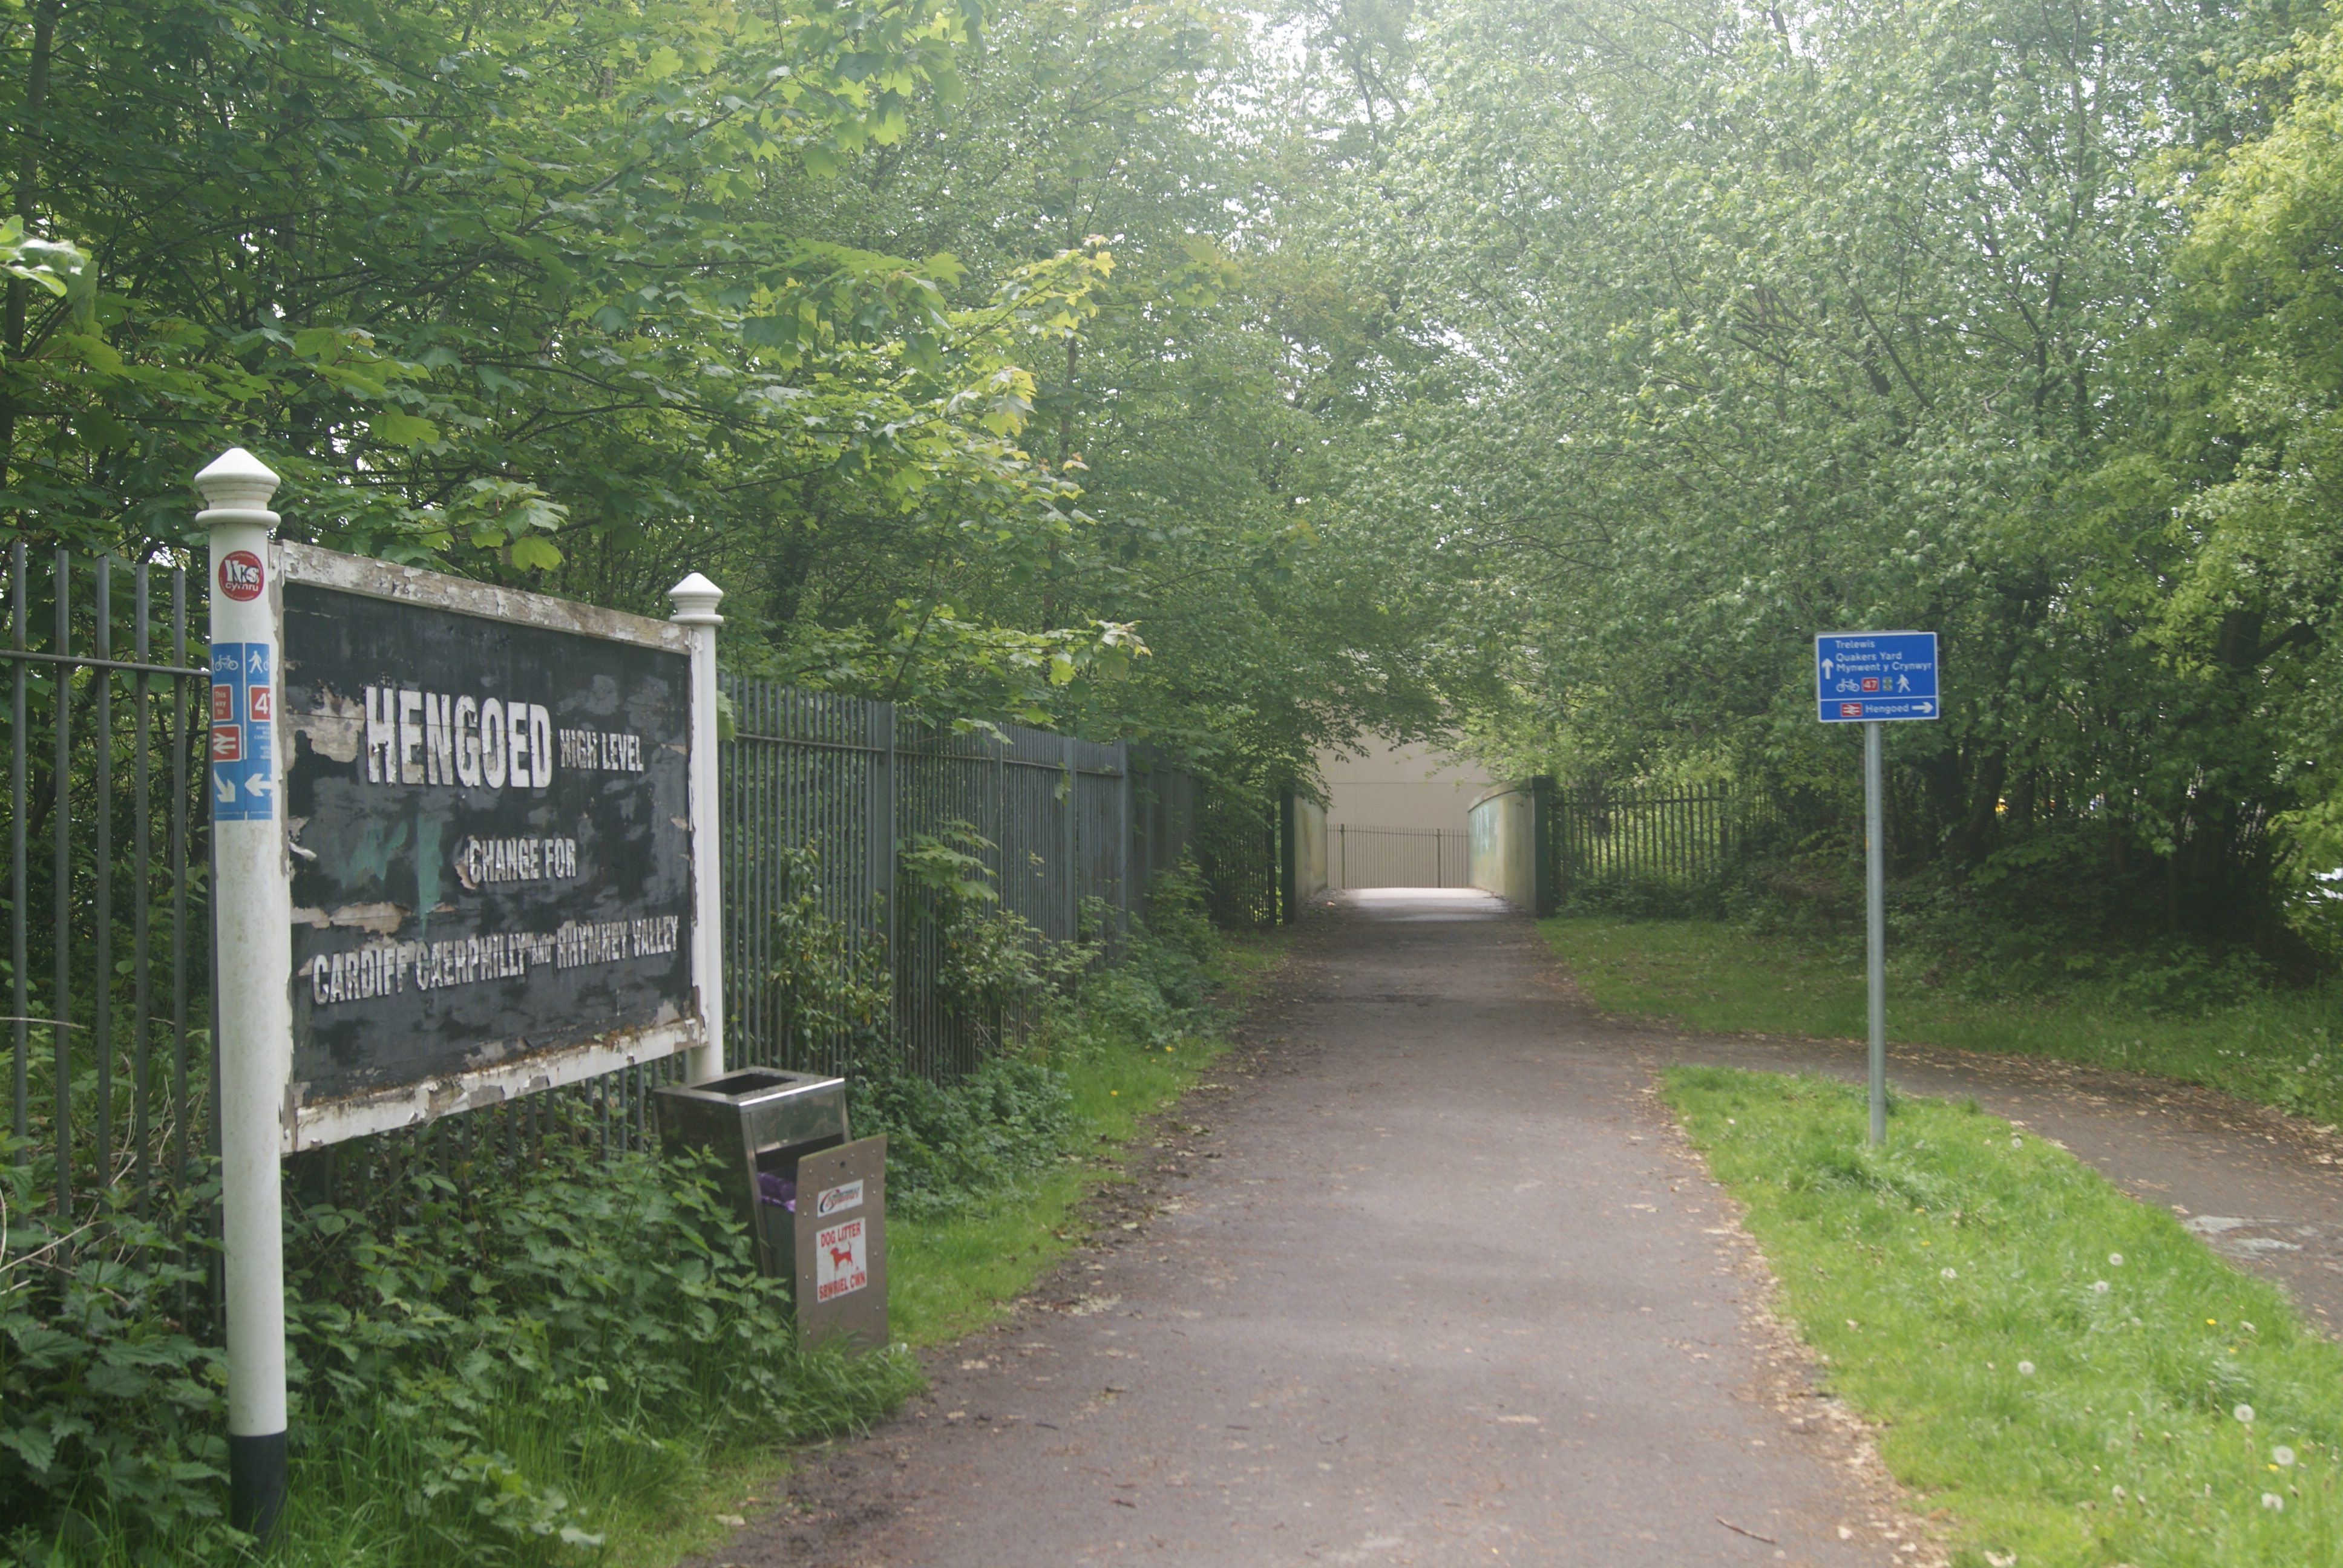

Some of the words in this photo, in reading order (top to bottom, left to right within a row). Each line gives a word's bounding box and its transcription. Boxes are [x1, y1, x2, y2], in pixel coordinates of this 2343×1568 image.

[1835, 639, 1875, 648] Trelewis
[1835, 653, 1876, 662] Quakers
[1879, 652, 1902, 660] Yard
[1837, 663, 1880, 673] Mynwent
[1892, 662, 1932, 671] Crynwyr
[1863, 680, 1877, 689] 47
[1865, 704, 1909, 714] Hengoed
[365, 687, 552, 789] HENGOED
[560, 729, 597, 769] HIGH
[601, 733, 644, 772] LEVEL
[469, 837, 539, 883] CHANGE
[545, 838, 575, 878] FOR
[313, 946, 408, 1005] CARDIFF
[416, 932, 525, 991] CAERPHILLY
[531, 935, 551, 965] AND
[557, 921, 627, 969] RHYMNEY
[632, 915, 678, 957] VALLEY
[821, 1229, 836, 1247] DOG
[837, 1222, 861, 1241] LITTER
[819, 1278, 848, 1299] SBWRIEL
